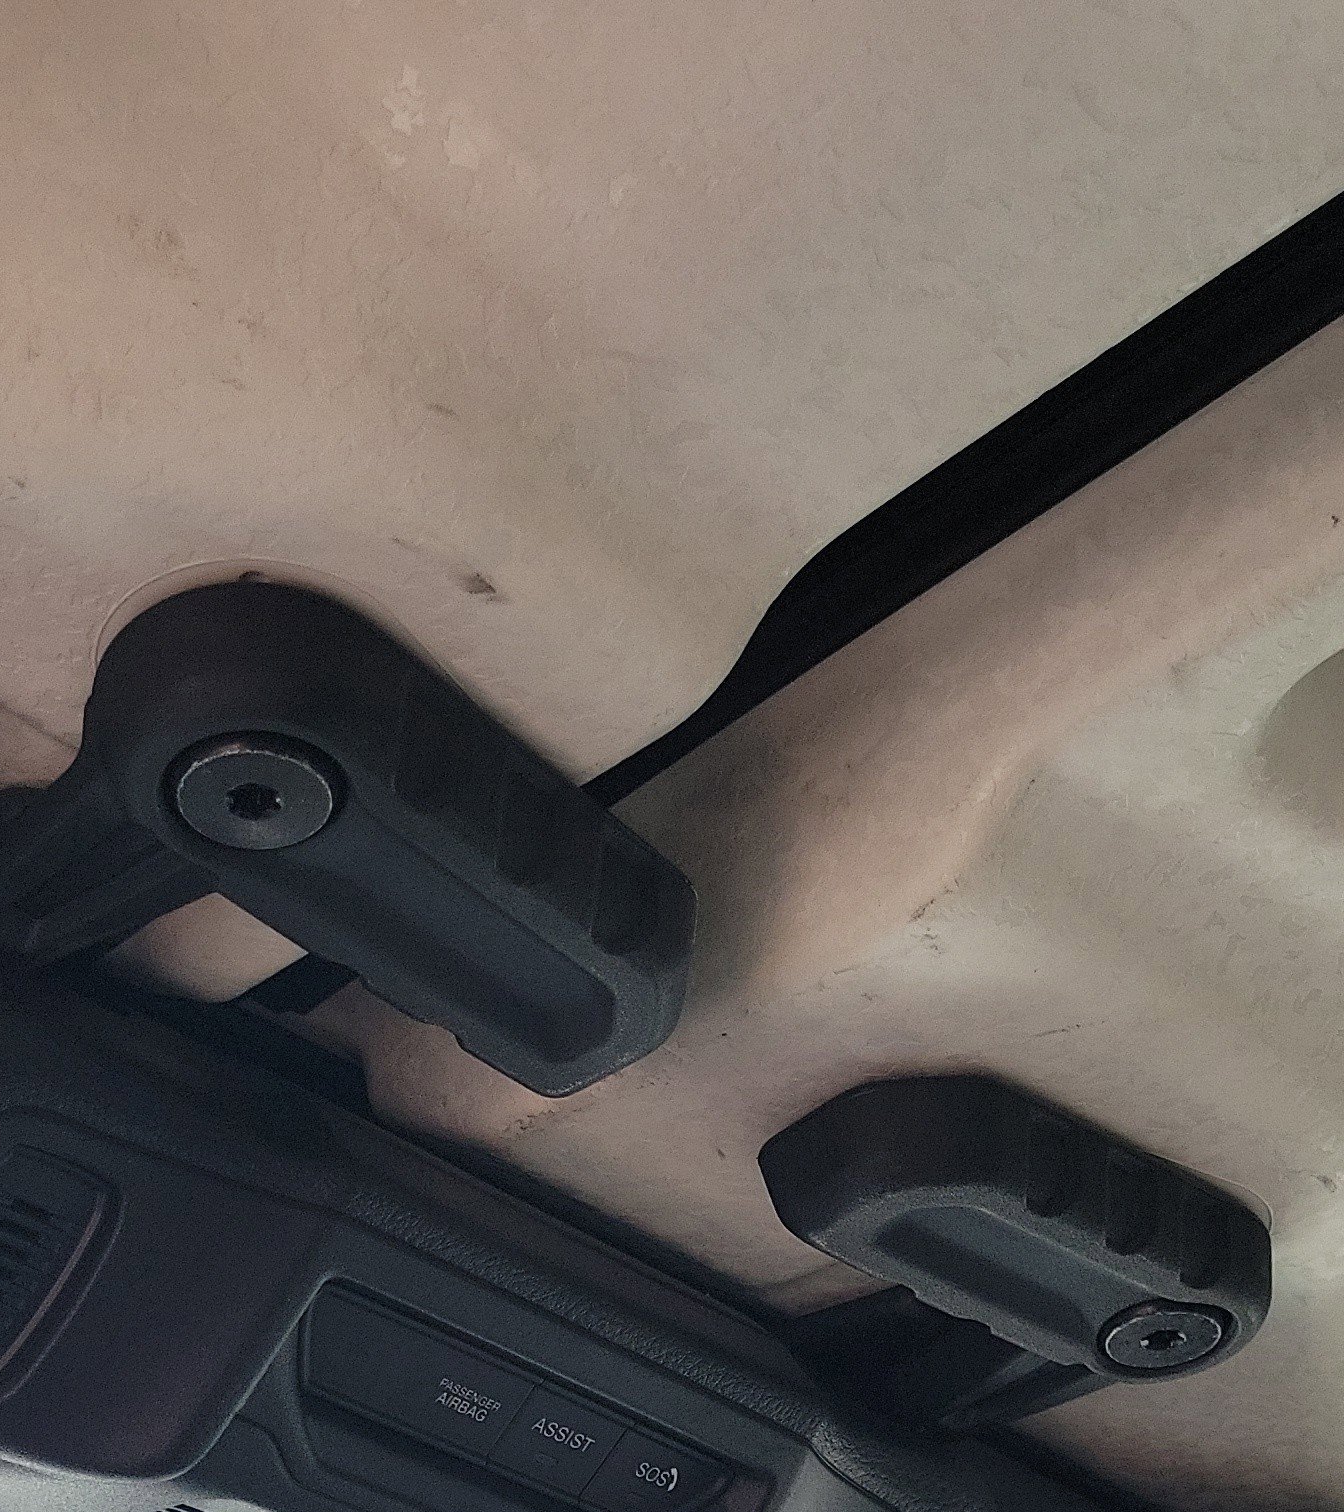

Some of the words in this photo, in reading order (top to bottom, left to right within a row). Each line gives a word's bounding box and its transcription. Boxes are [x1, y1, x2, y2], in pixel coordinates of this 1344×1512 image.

[435, 1392, 486, 1423] AIRBAG
[439, 1378, 501, 1413] PASSENGER
[531, 1417, 596, 1453] ASSIST
[635, 1462, 669, 1488] SOS
